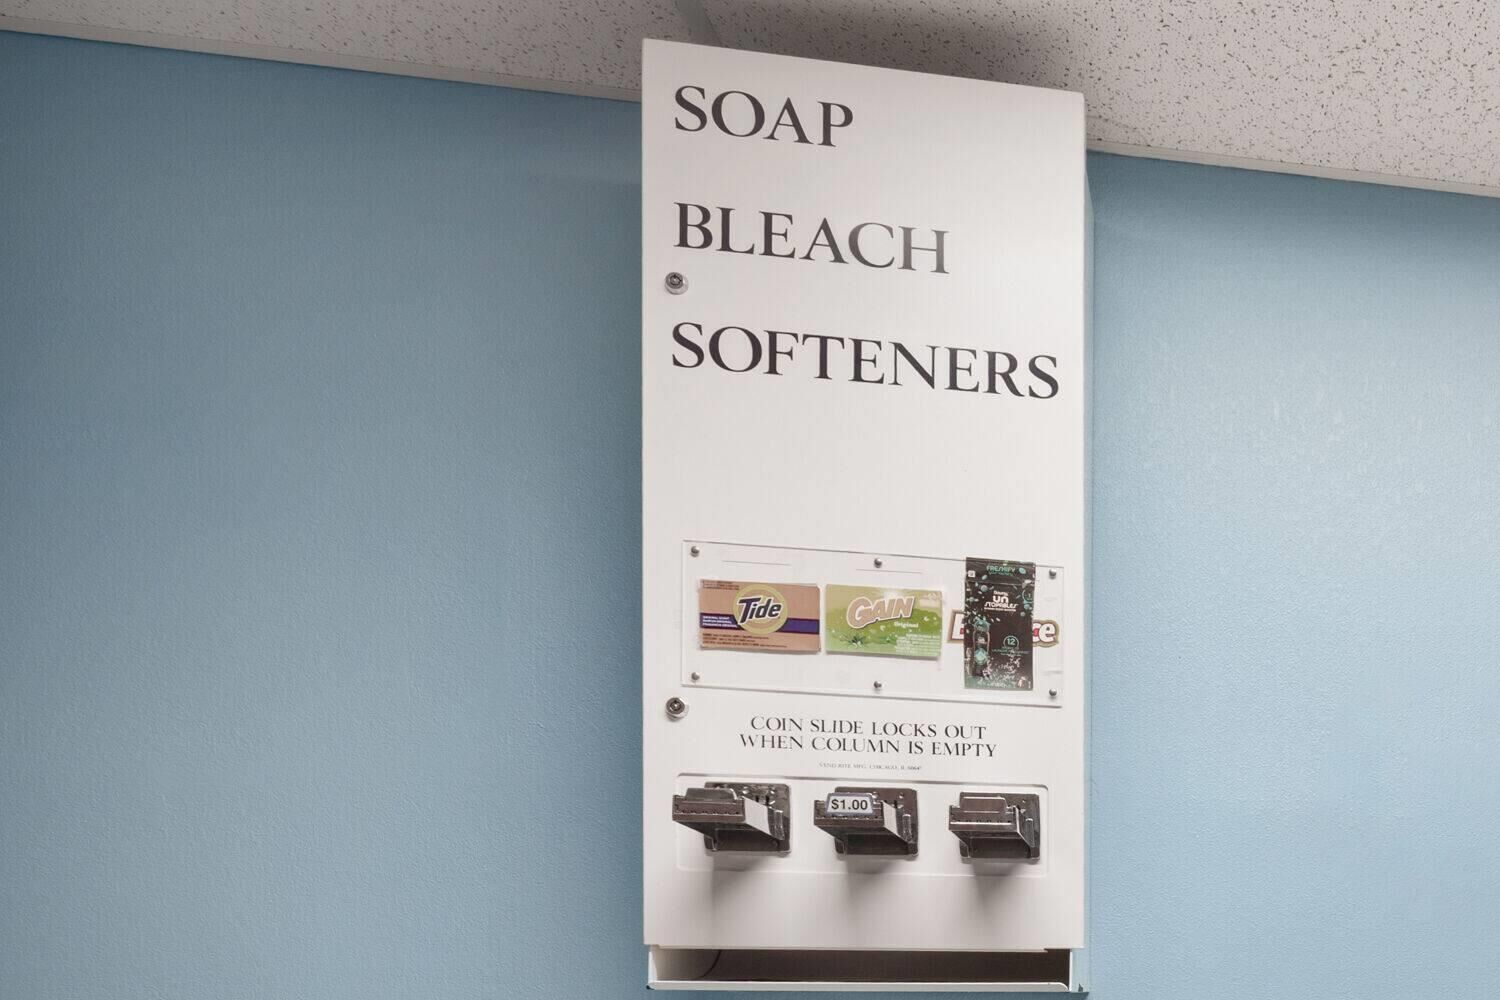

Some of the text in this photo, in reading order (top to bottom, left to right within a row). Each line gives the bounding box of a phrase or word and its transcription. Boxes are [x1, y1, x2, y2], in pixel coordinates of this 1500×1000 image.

[673, 84, 854, 148] SOAP
[673, 202, 950, 275] BLEACH
[671, 321, 1060, 400] SOFTENERS
[737, 596, 783, 625] Tide
[1006, 638, 1016, 646] 12
[751, 715, 987, 740] COIN SLIDE LOCKS OUT
[740, 734, 998, 758] WHEN COLUMN IS EMPTY
[830, 796, 869, 812] $1.00
